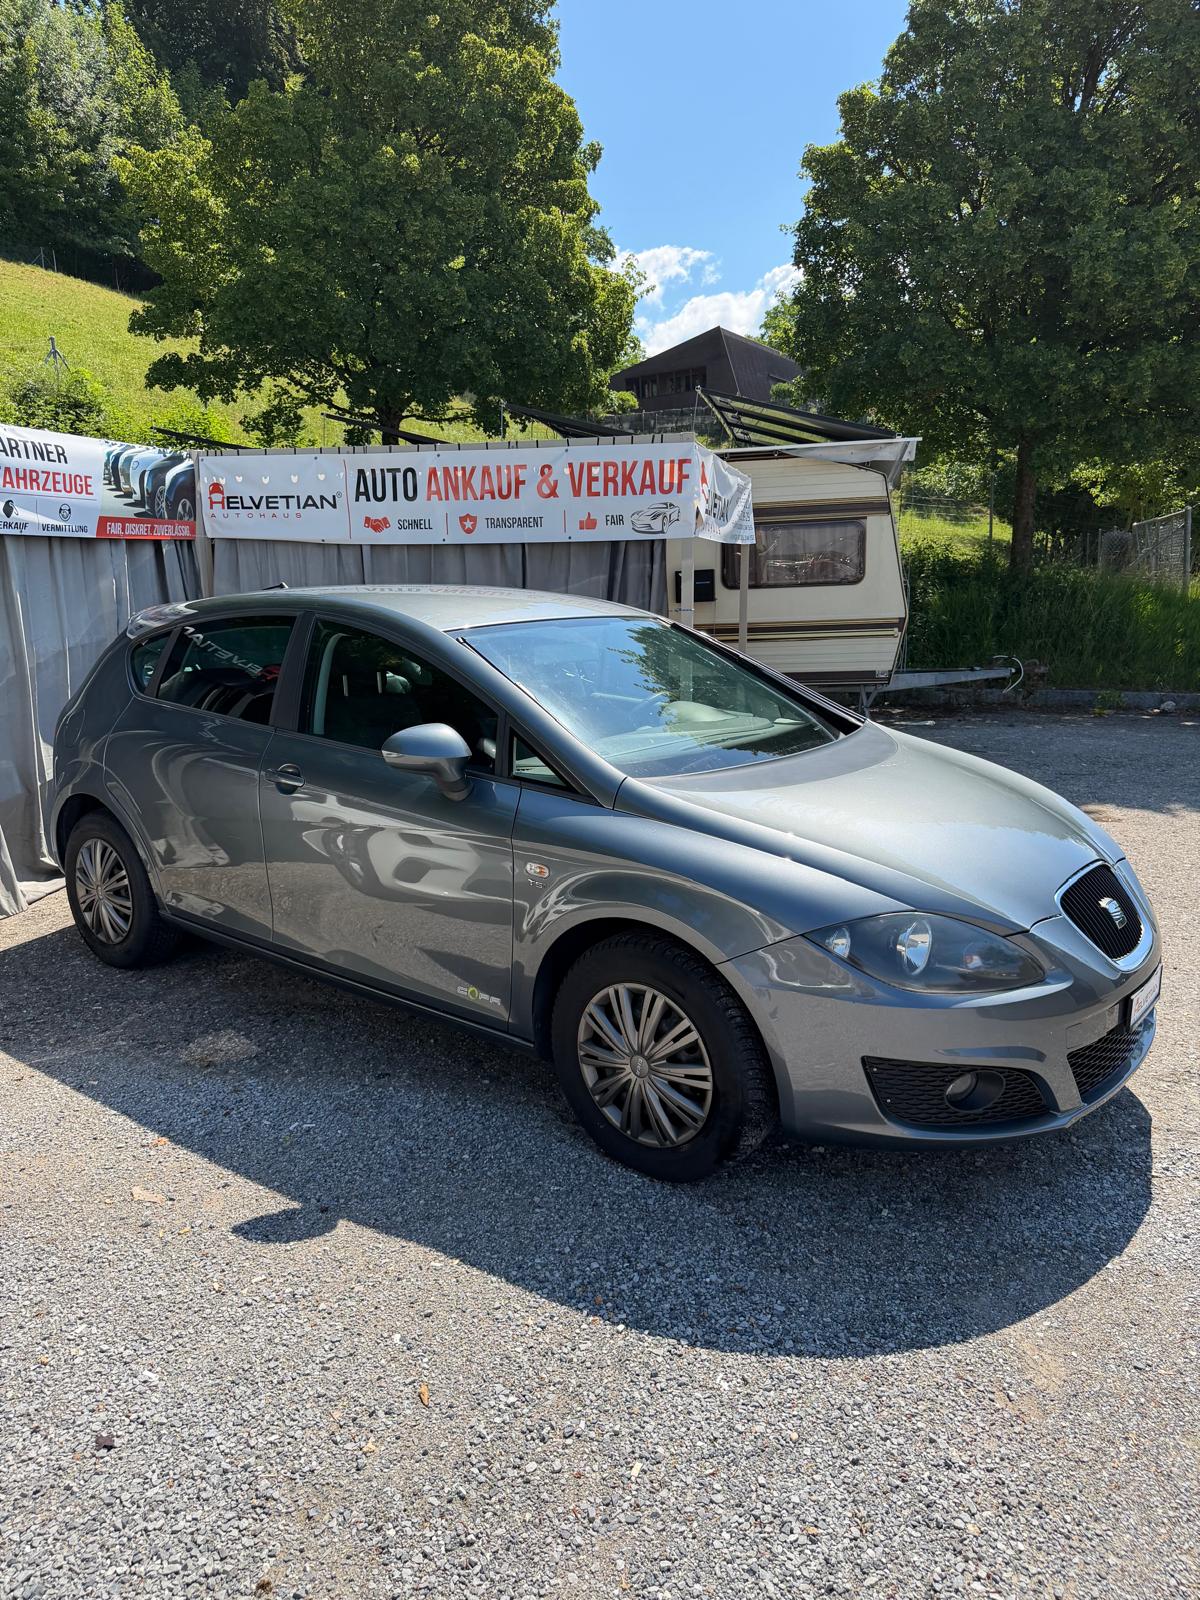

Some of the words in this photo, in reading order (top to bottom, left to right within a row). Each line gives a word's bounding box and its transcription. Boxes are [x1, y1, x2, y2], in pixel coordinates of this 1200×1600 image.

[0, 466, 94, 496] AHRZEUGE
[354, 467, 418, 502] AUTO
[426, 464, 527, 501] ANKAUF
[536, 464, 559, 499] &
[567, 458, 692, 498] VERKAUF
[397, 518, 433, 530] SCHNELL
[485, 516, 544, 529] TRANSPARENT
[605, 514, 625, 526] FAIR
[42, 524, 88, 534] VERMITTLUNG
[107, 522, 124, 535] FAIR.
[125, 523, 152, 536] DISKRET.
[153, 524, 192, 537] ZUVERLÄSSIG.
